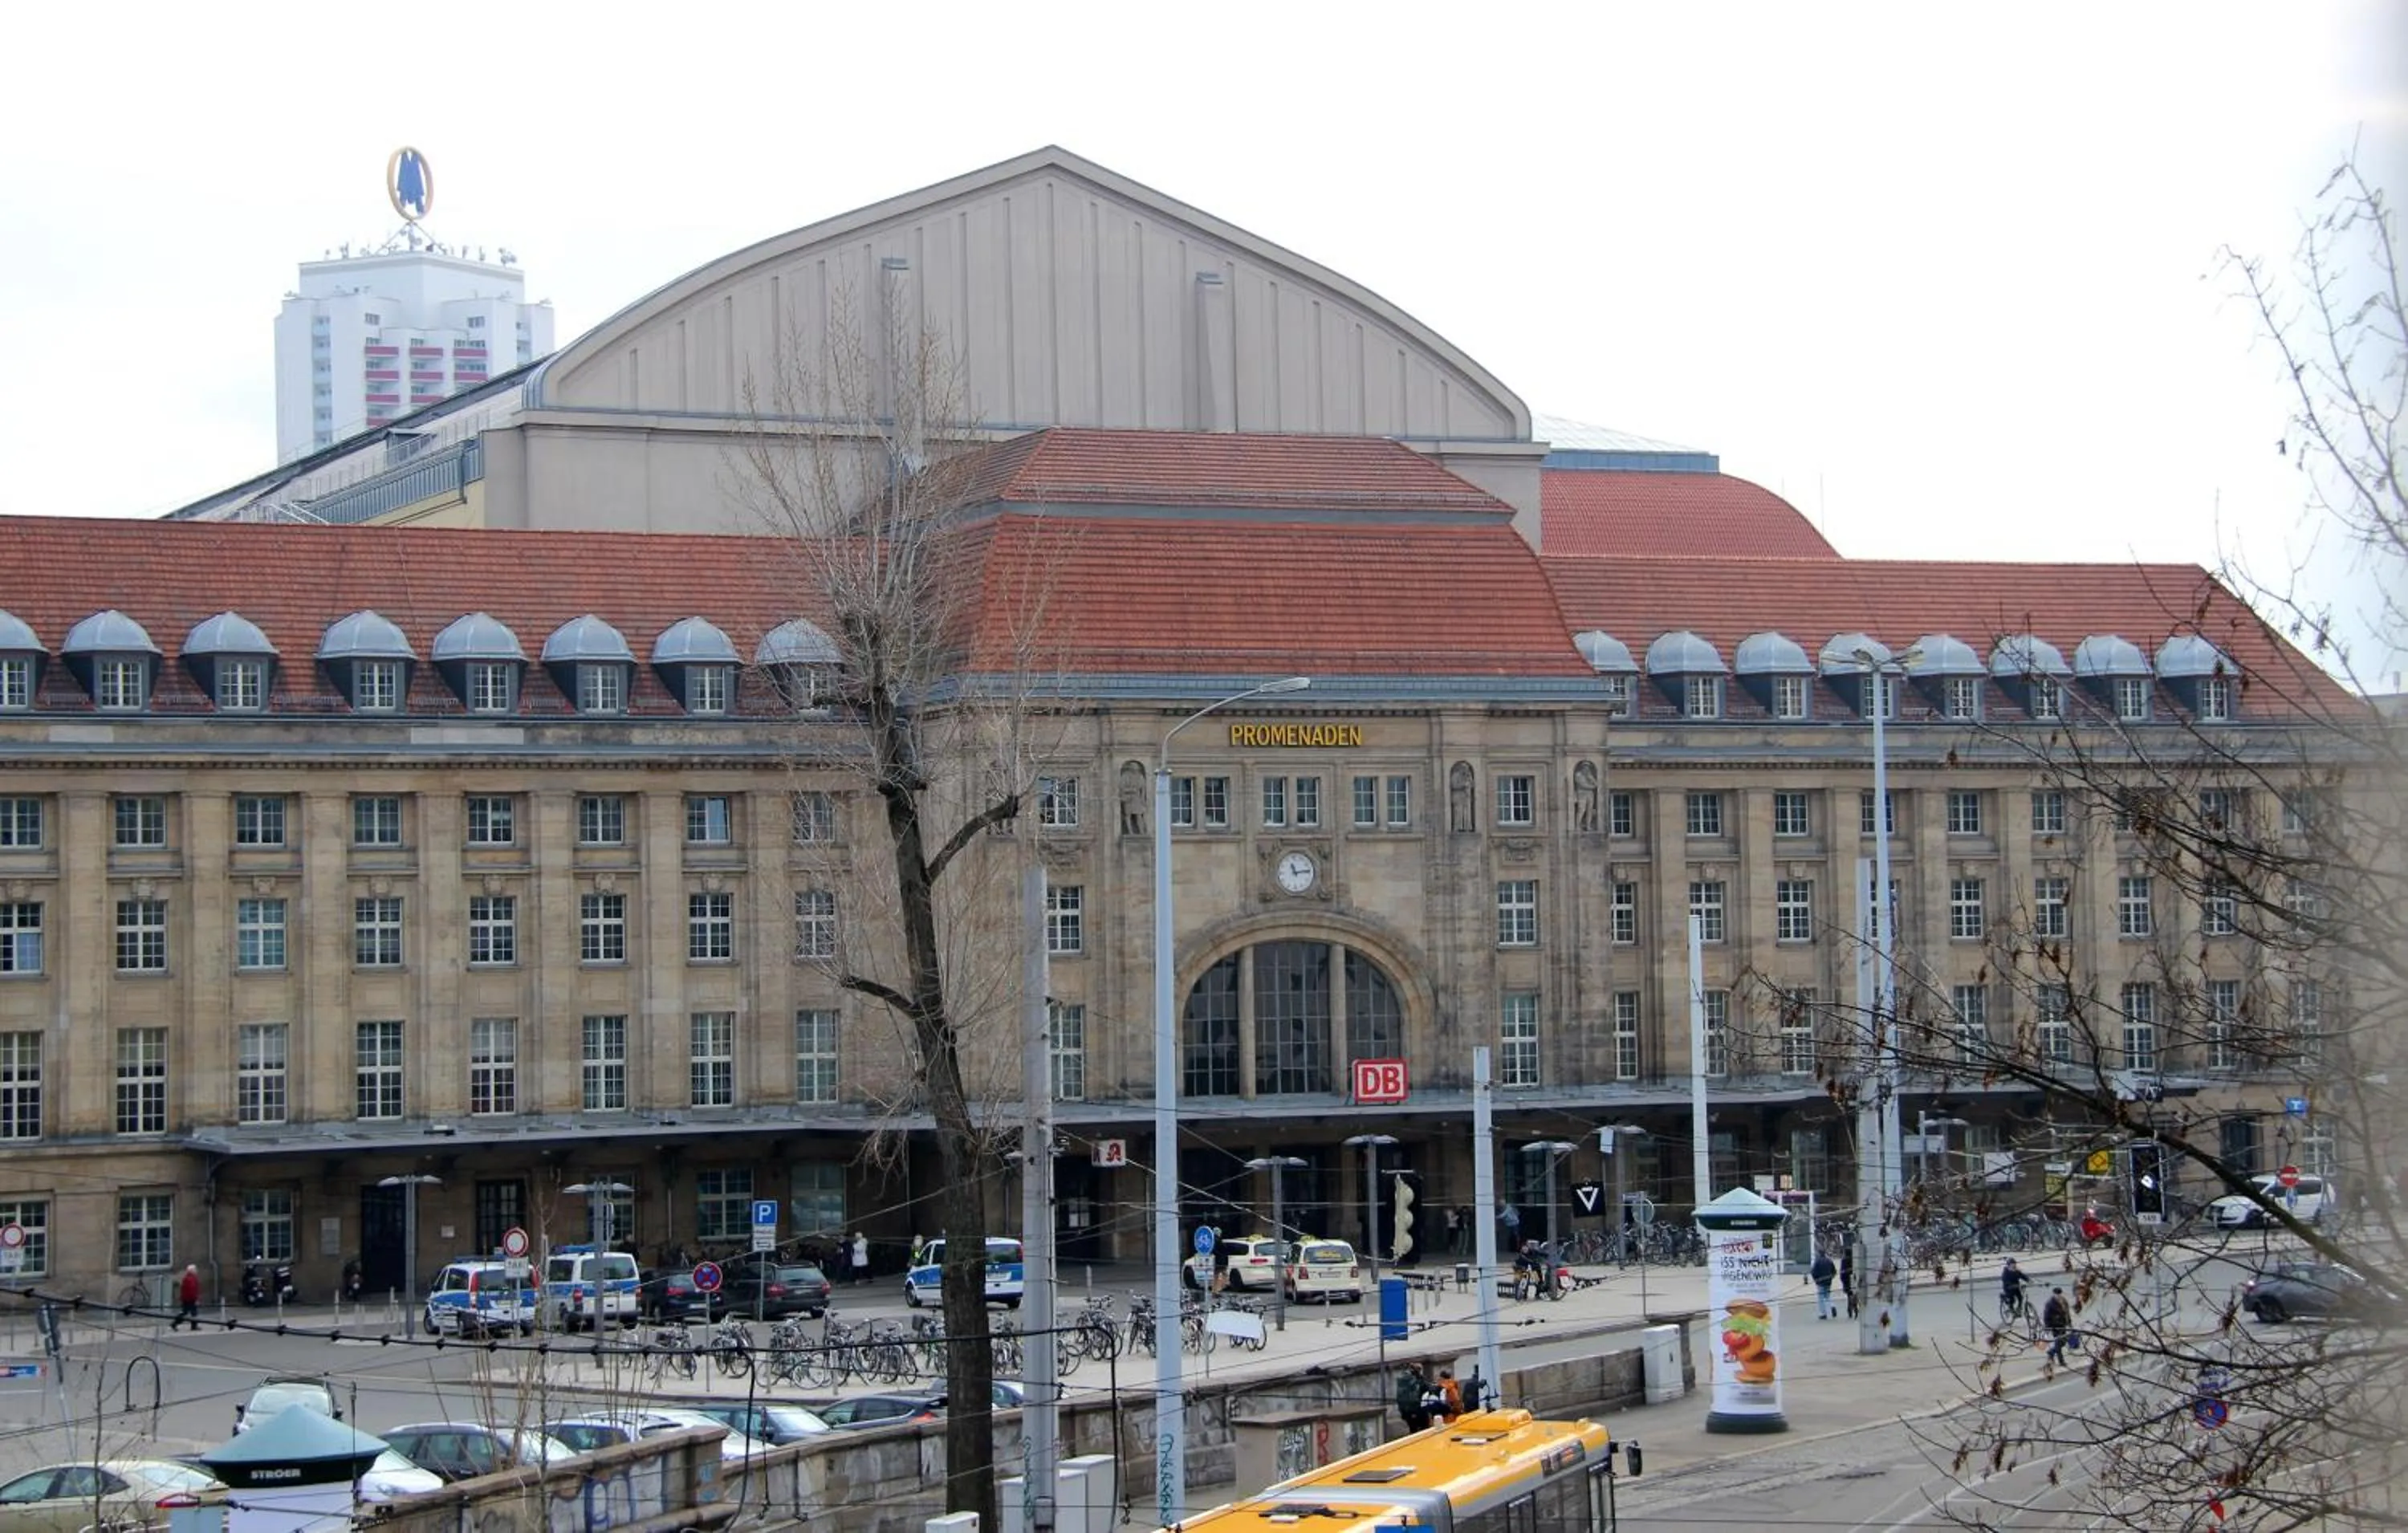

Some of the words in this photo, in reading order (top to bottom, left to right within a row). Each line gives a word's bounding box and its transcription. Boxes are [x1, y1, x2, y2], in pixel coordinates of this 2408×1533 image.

[1231, 725, 1362, 746] PROMENADEN
[1361, 1066, 1401, 1095] DB
[759, 1205, 771, 1222] P
